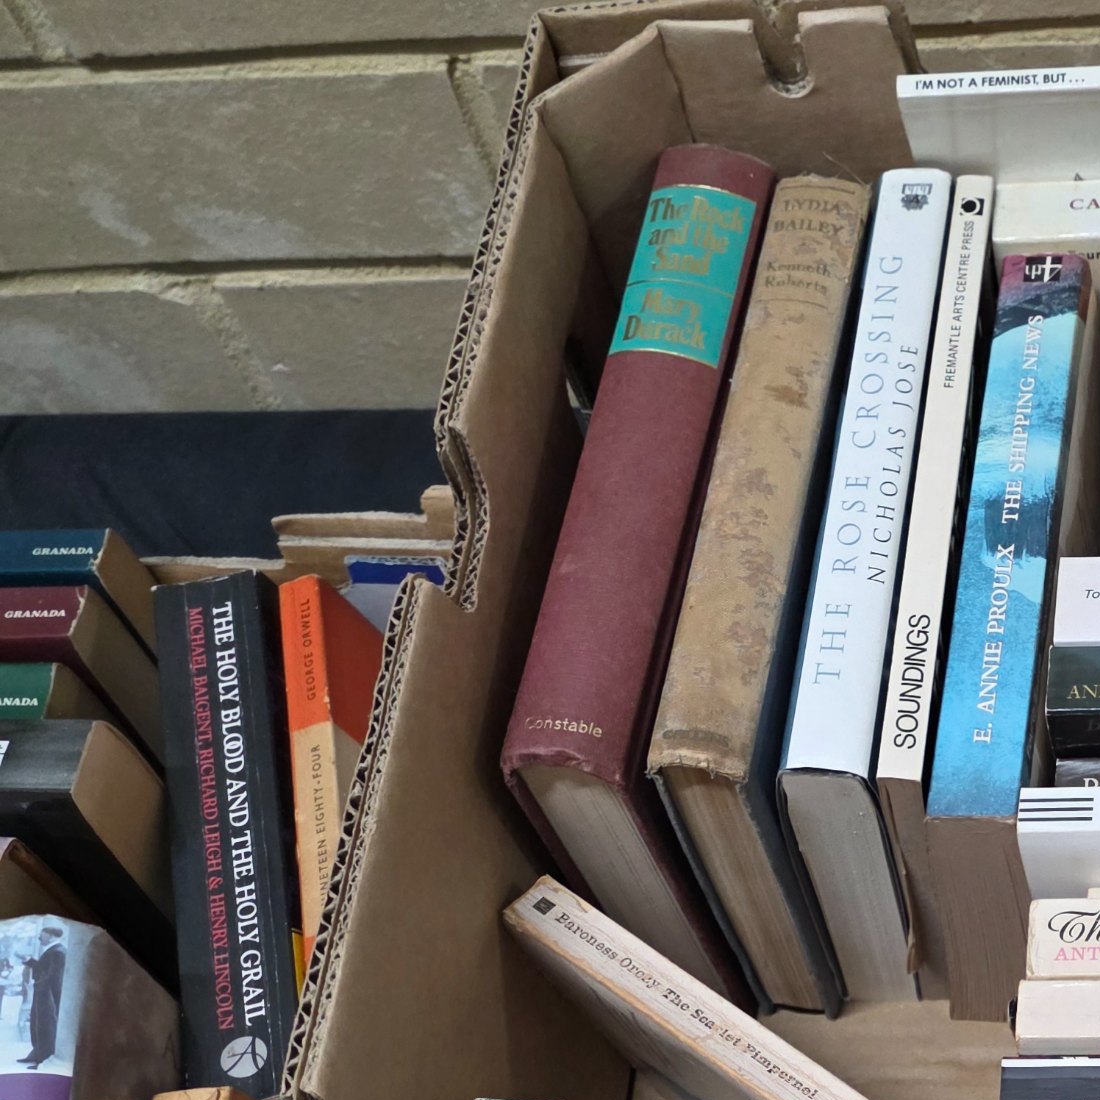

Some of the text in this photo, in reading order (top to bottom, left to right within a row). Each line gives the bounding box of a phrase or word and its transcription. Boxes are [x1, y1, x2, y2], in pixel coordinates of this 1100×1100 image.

[914, 80, 933, 90] I'M
[937, 78, 965, 89] NOT
[967, 78, 978, 88] A
[980, 75, 1040, 87] FEMINIST,
[943, 220, 975, 388] FREMANTLE ARTS CENTRE PRESS
[812, 256, 904, 685] THE ROSE CROSSING
[866, 345, 920, 585] NICHOLAS JOSE
[32, 547, 94, 556] GRANADA
[972, 314, 1045, 744] E. ANNIE PROULX THE SHIPPING NEWS
[4, 609, 66, 619] GRANADA
[188, 607, 207, 673] MICHAEL
[300, 598, 316, 700] GEORGE ORWELL
[893, 613, 931, 750] SOUNDINGS
[524, 717, 603, 738] Constable
[199, 748, 219, 821] RICHARD
[203, 823, 223, 878] LEIGH
[207, 877, 223, 890] &
[209, 893, 229, 949] HENRY
[213, 951, 235, 1031] LINCOLN
[555, 912, 620, 961] Baroness
[619, 957, 660, 990] Orczy
[661, 988, 690, 1012] The
